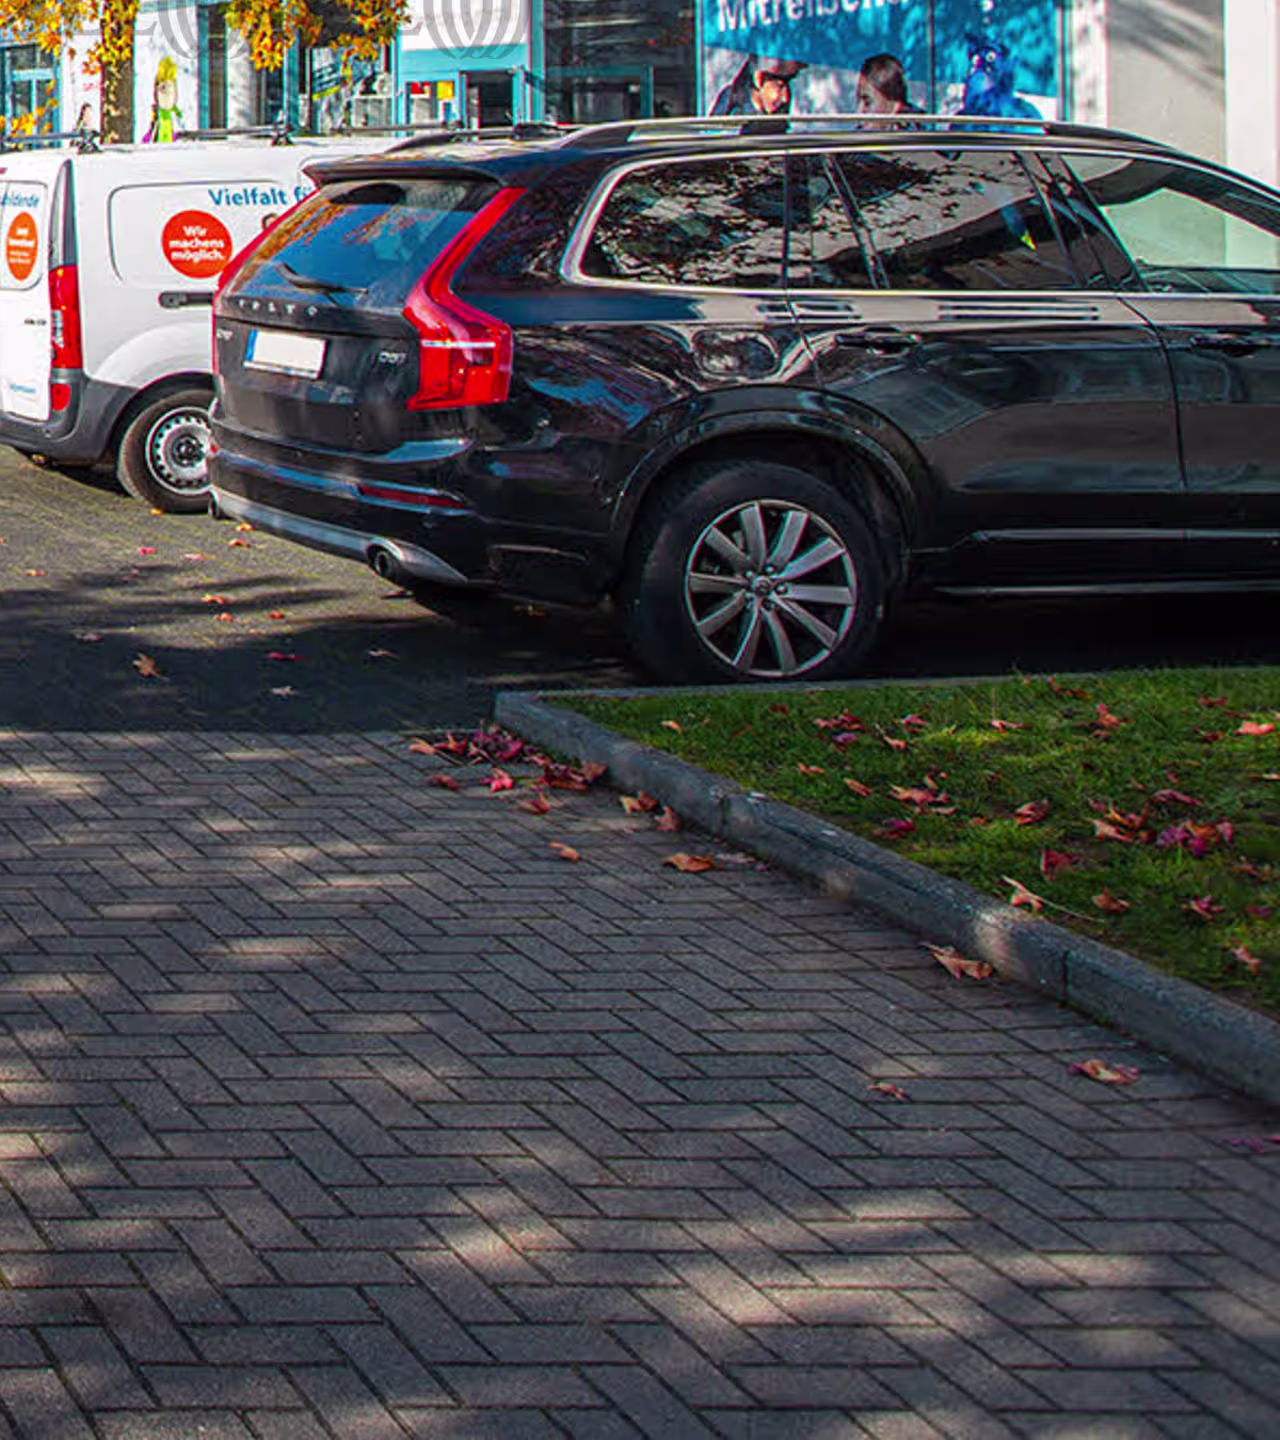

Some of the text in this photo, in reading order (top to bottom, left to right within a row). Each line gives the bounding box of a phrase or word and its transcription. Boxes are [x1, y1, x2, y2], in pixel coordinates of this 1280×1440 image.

[208, 186, 288, 207] Vielfalt
[182, 225, 208, 237] Wir
[168, 237, 225, 249] machens
[170, 249, 225, 263] möglich.
